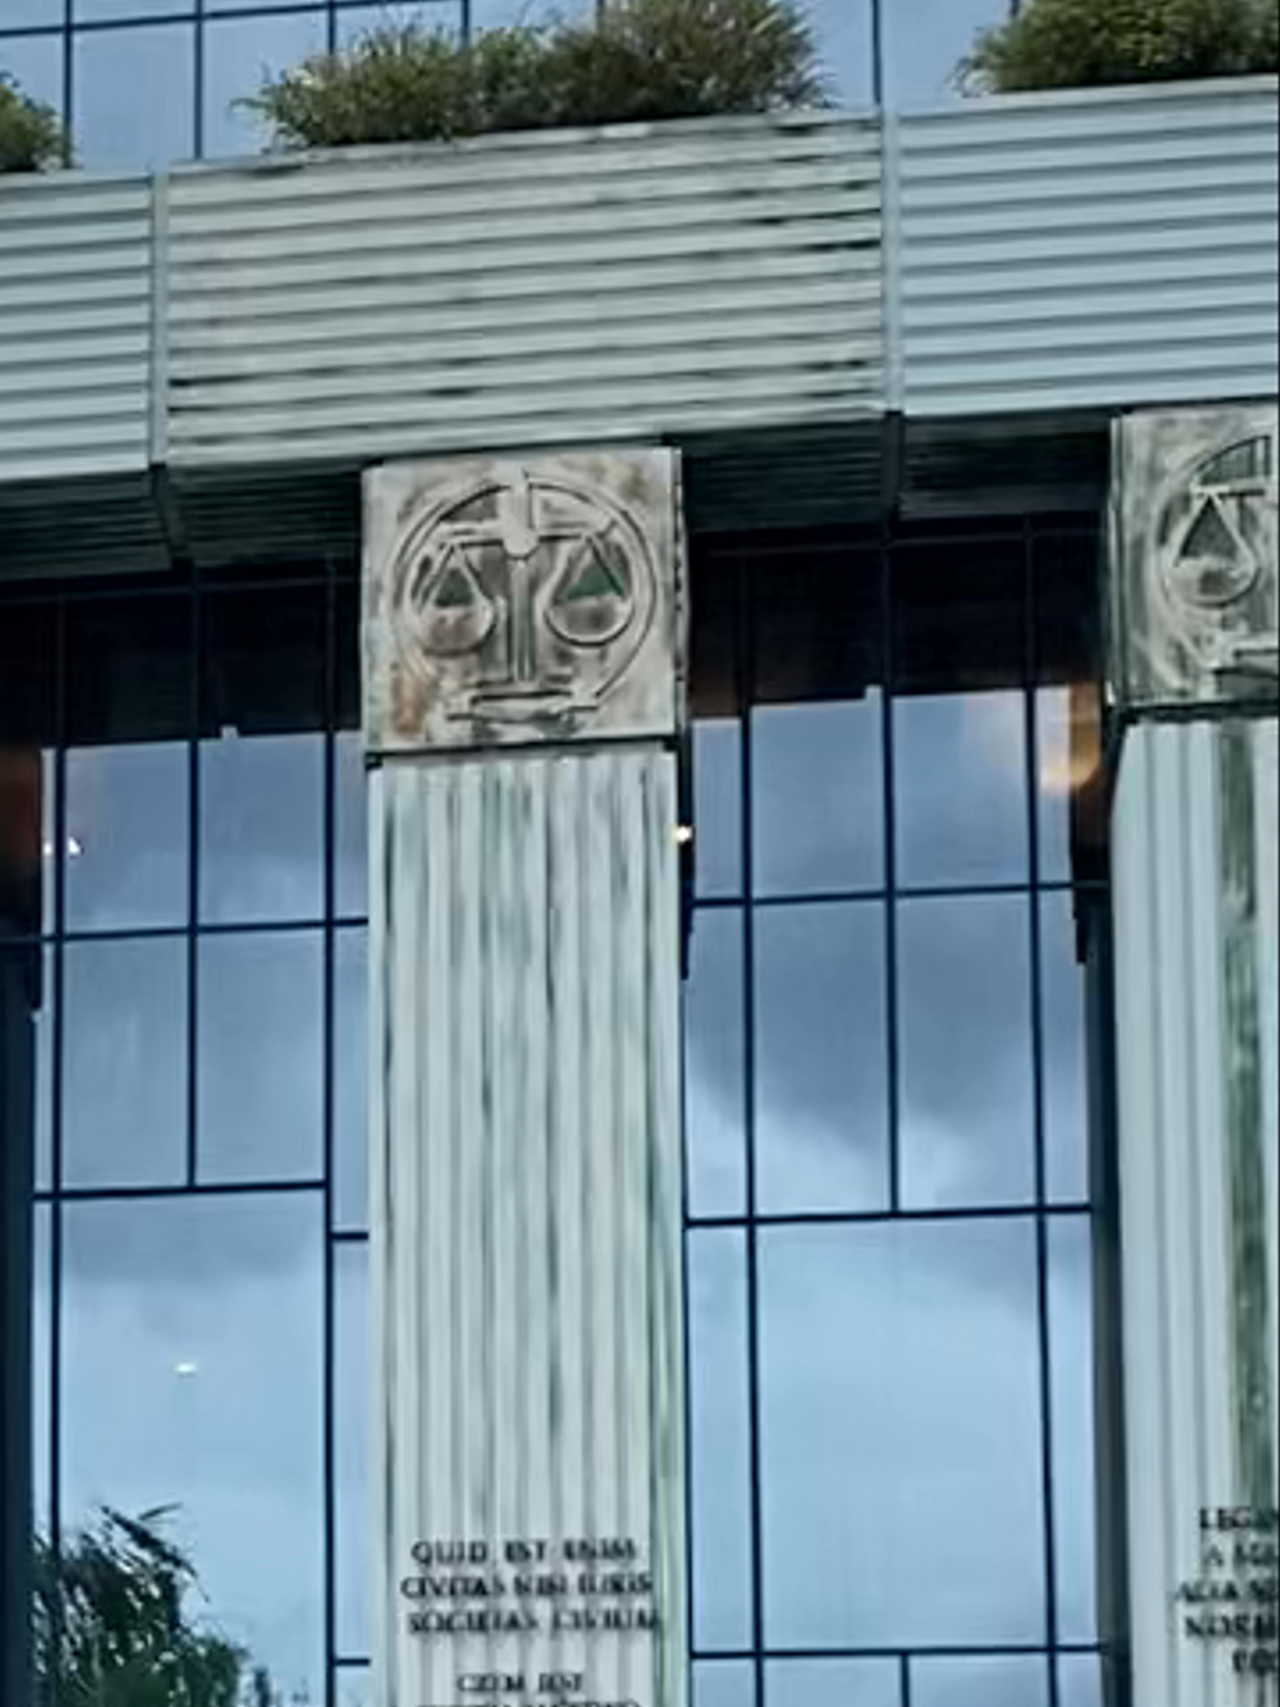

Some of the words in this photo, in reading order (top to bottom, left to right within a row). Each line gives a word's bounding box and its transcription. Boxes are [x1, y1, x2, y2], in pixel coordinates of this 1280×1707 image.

[411, 1540, 488, 1567] QUID
[504, 1538, 546, 1564] EST
[564, 1537, 637, 1562] ENIM
[400, 1575, 505, 1599] CIVITAS
[409, 1610, 537, 1635] SOCIETAS
